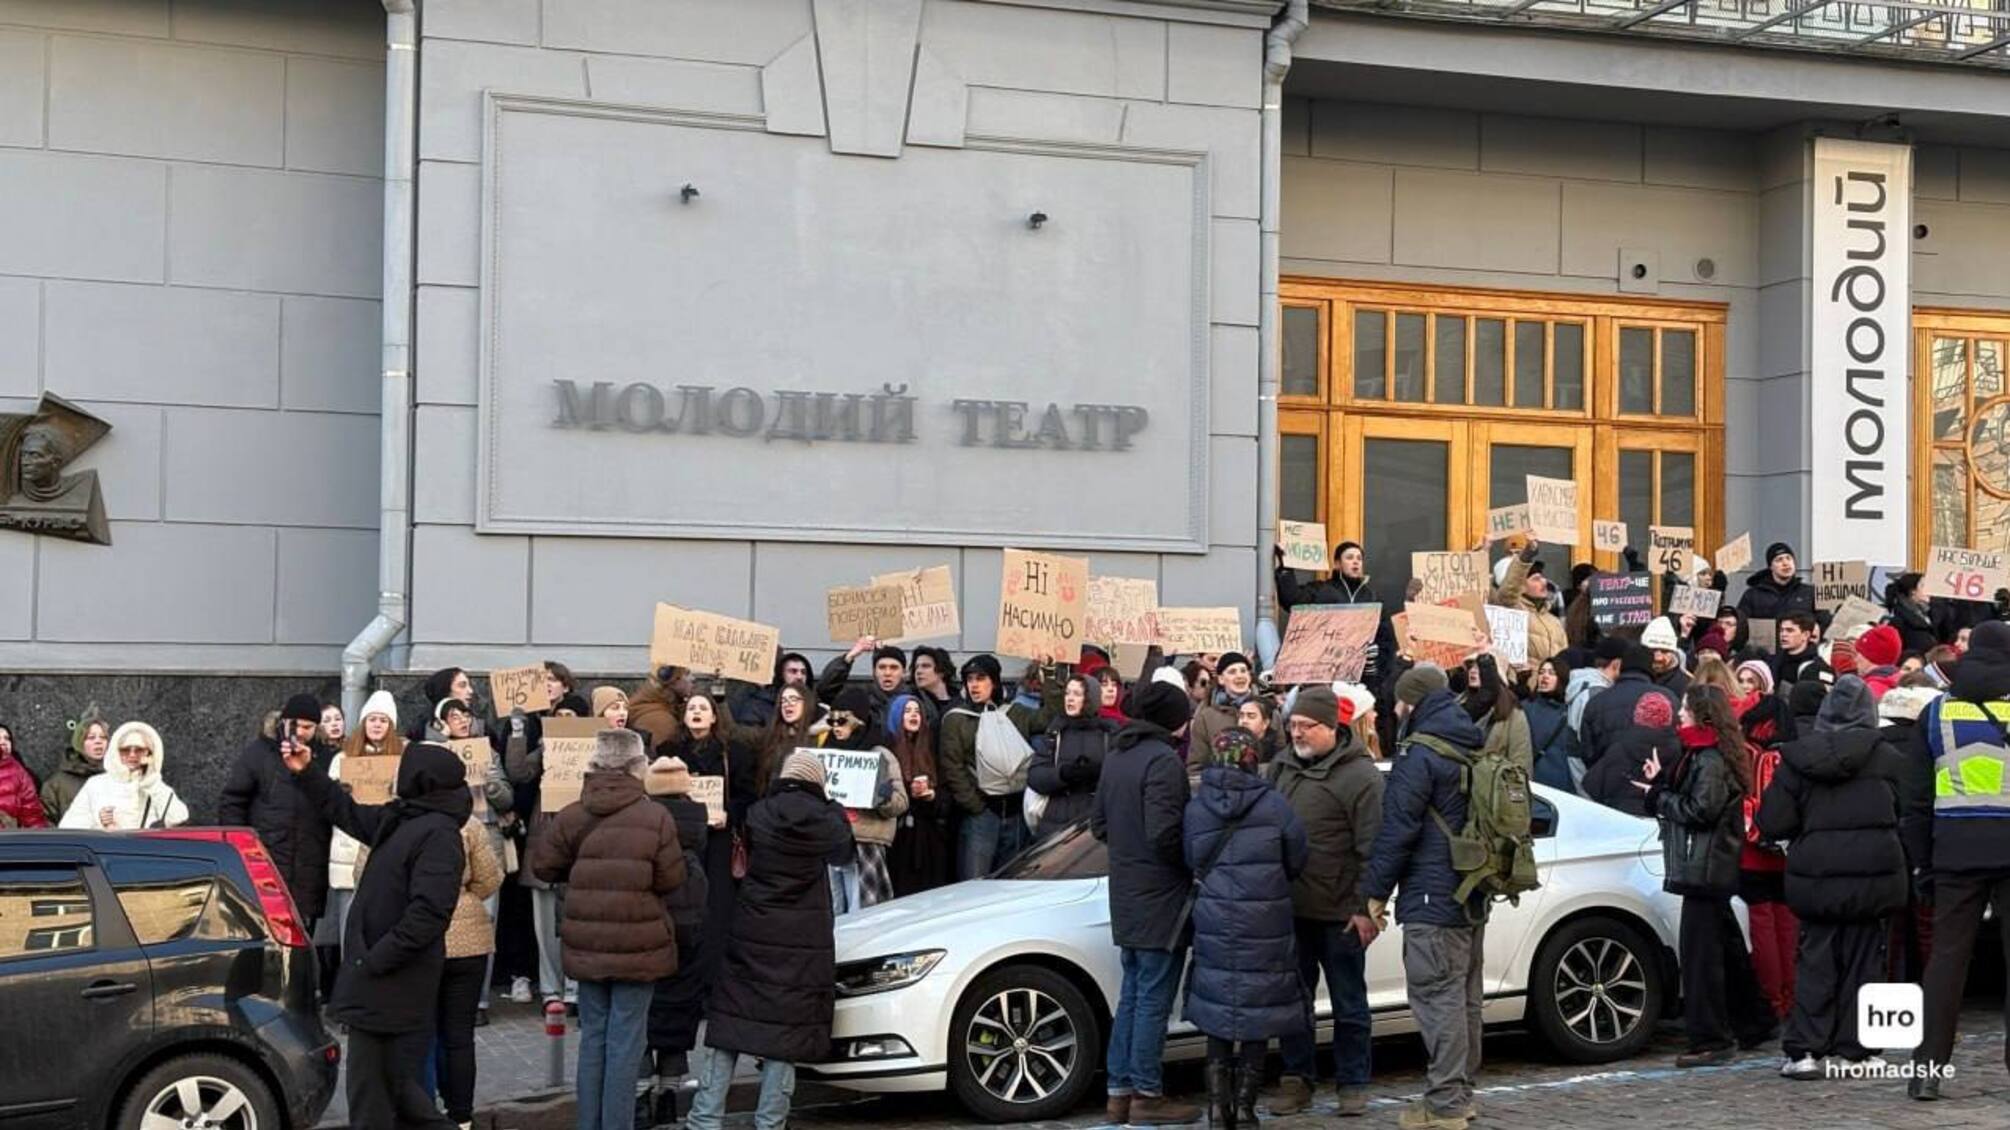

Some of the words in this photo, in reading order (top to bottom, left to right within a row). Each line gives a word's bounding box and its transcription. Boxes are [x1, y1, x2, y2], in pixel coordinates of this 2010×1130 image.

[552, 379, 919, 446] МОЛОДИЙ
[953, 399, 1149, 451] ТЕАТР
[1492, 511, 1515, 532] НЕ
[1597, 524, 1619, 544] 46
[1427, 553, 1472, 576] СТОП
[1658, 548, 1682, 573] 46
[1944, 571, 1984, 597] 46
[738, 650, 762, 672] 46
[505, 686, 528, 706] 46
